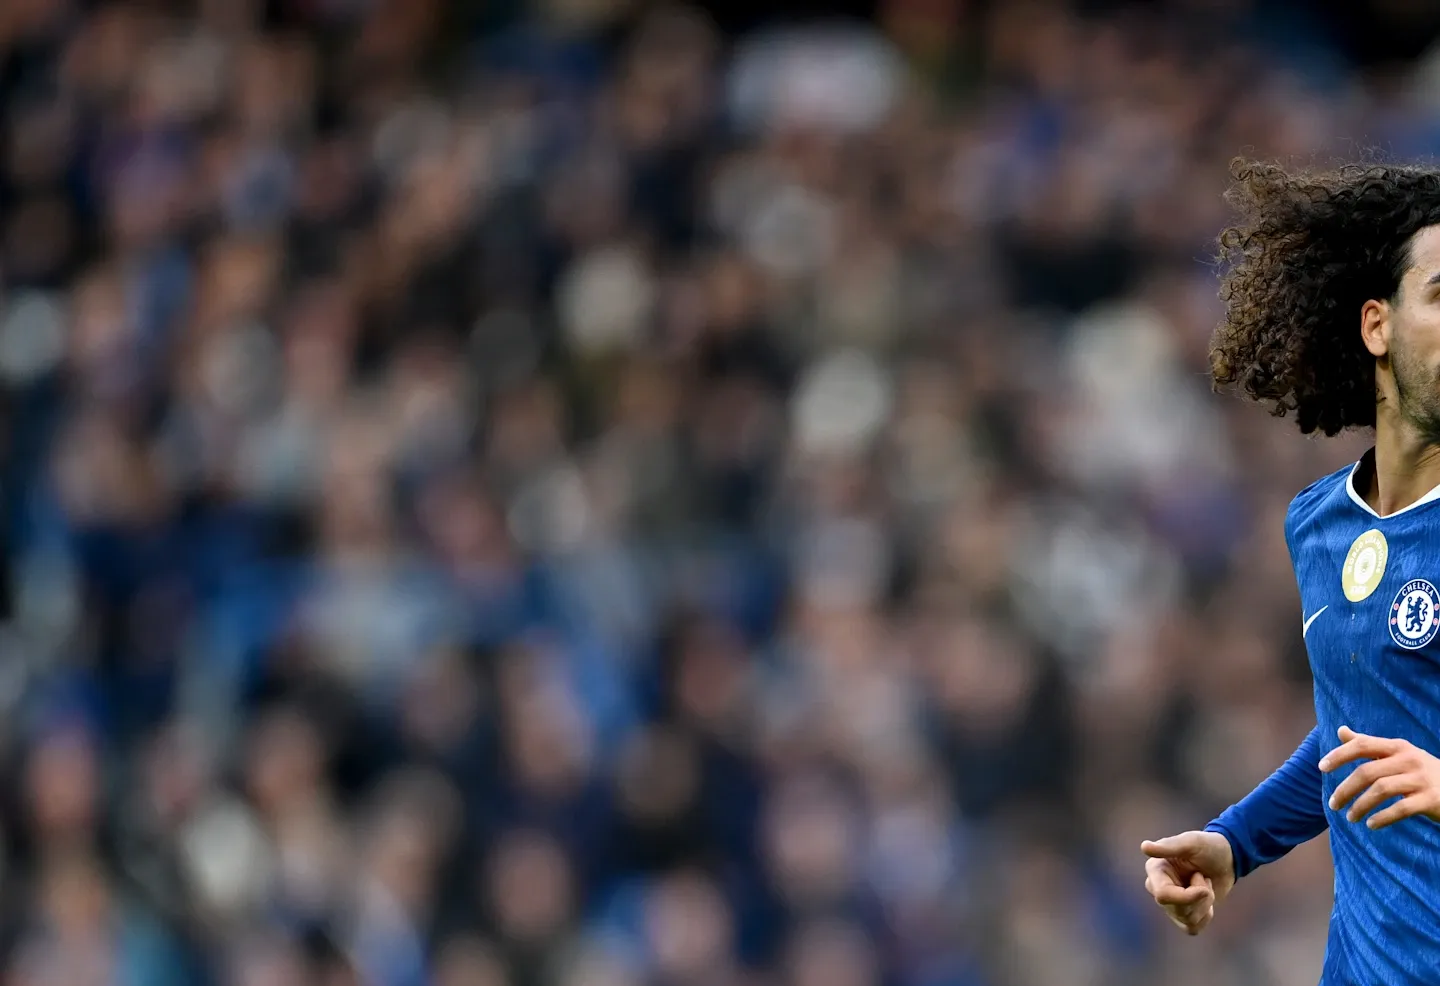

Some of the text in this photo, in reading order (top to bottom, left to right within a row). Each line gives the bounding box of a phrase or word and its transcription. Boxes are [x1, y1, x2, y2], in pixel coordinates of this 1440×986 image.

[1402, 582, 1434, 597] CHELSEA
[1395, 632, 1431, 645] FOOTBALL CLUB
